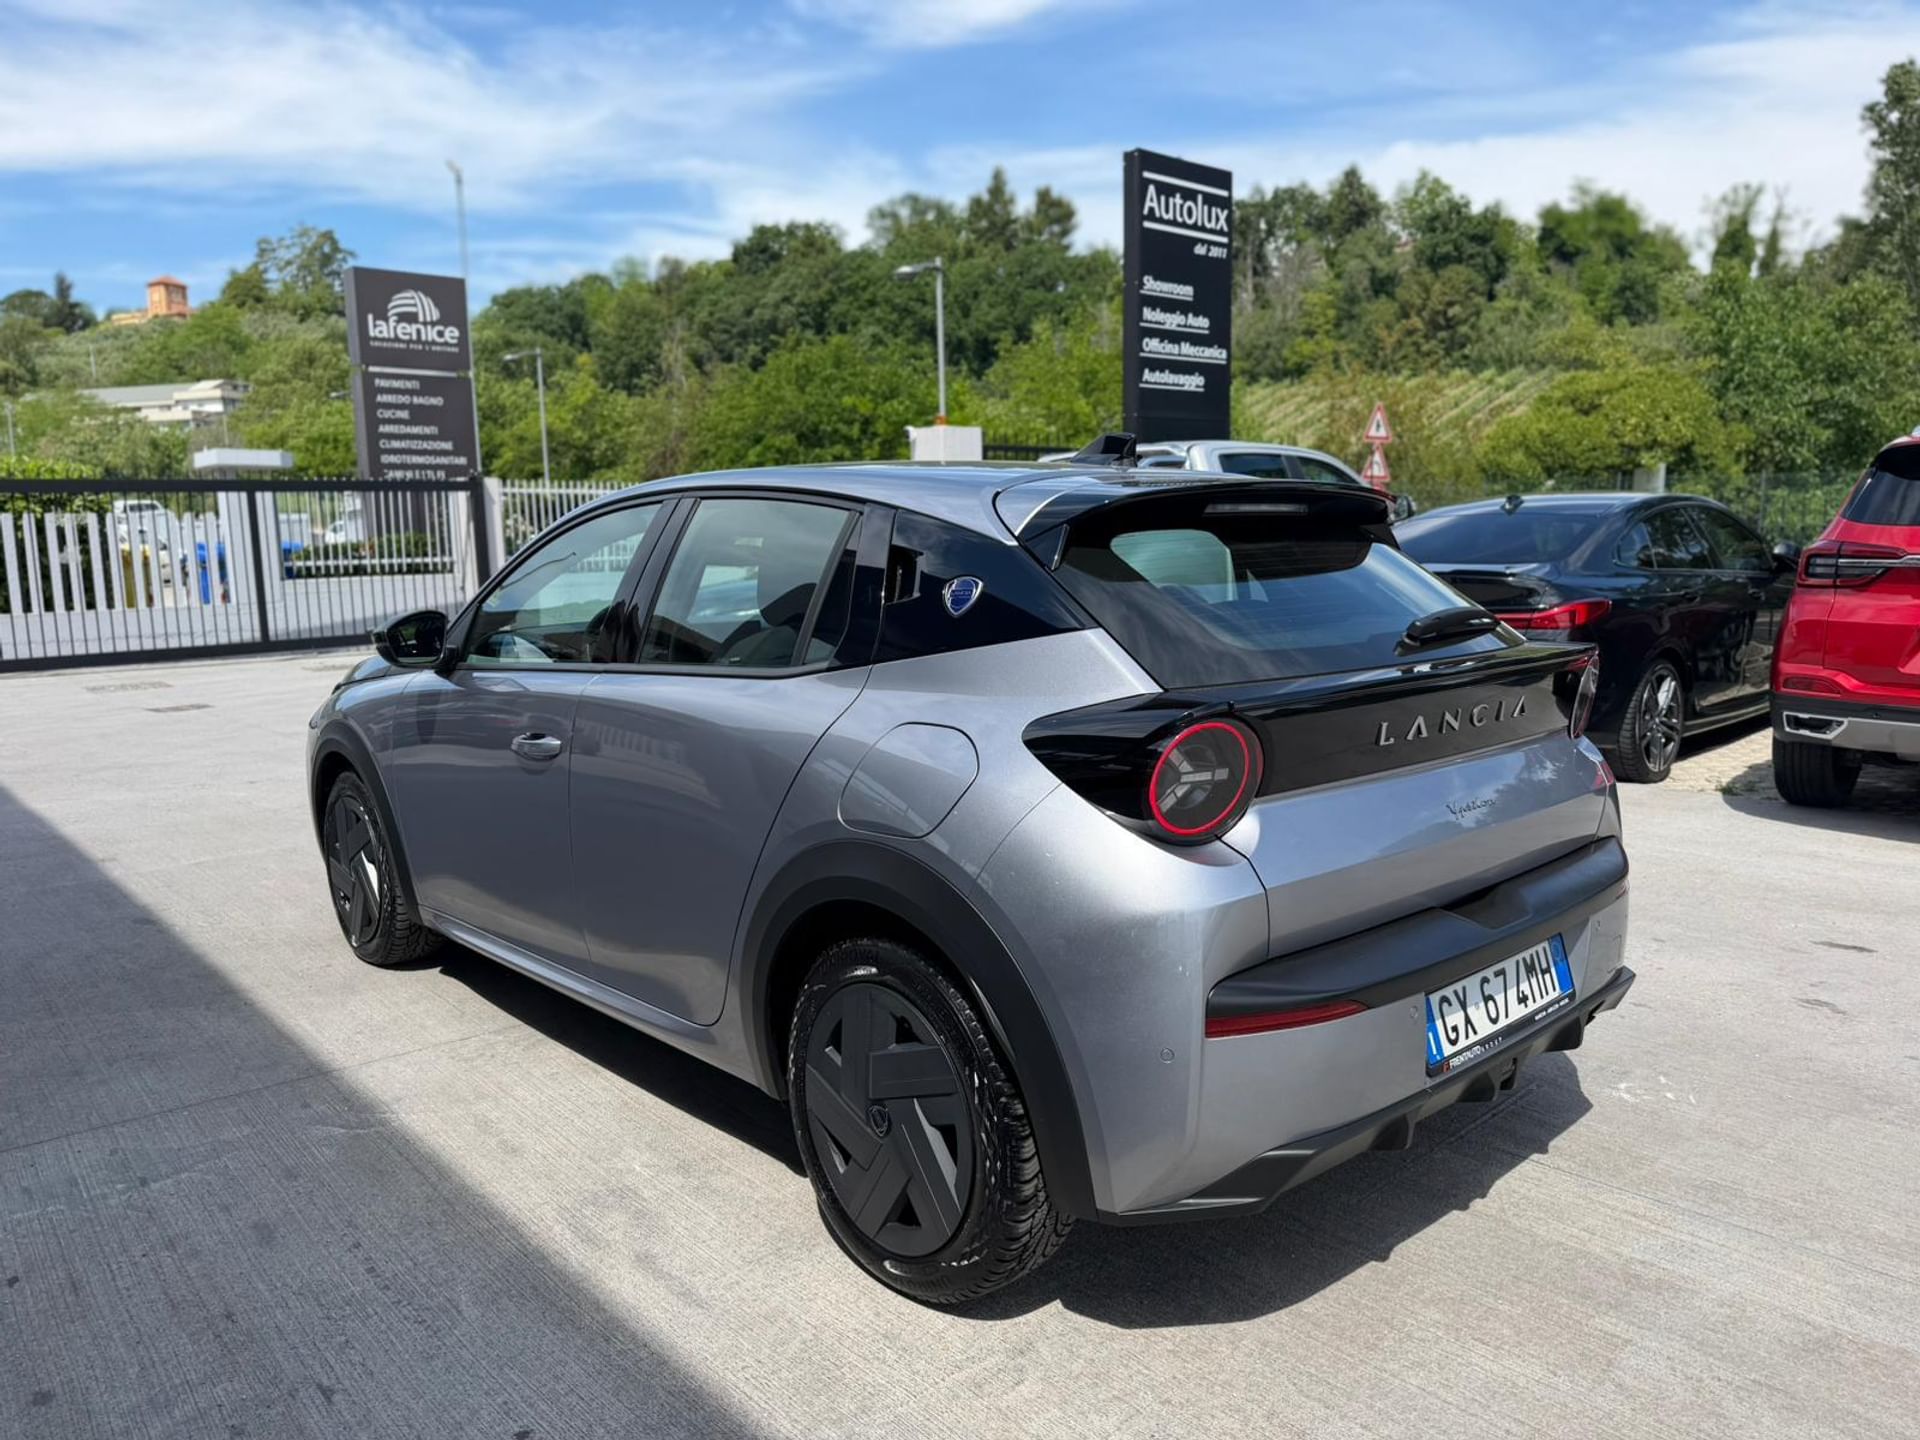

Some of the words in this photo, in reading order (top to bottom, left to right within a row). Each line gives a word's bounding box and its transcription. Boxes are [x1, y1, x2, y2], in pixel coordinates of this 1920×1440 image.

[1143, 184, 1228, 232] Autolux
[1143, 275, 1194, 297] Showroom
[1143, 307, 1186, 328] Noleggio
[1187, 313, 1209, 328] Auto
[367, 313, 460, 344] lafenice
[1142, 337, 1179, 355] Officina
[1180, 341, 1227, 360] Meccanica
[374, 377, 420, 390] PAVIMENTI
[1142, 368, 1205, 390] Autolavaggio
[376, 393, 411, 405] ARREDO
[412, 395, 444, 406] BAGNO
[376, 408, 410, 420] CUCINE
[377, 423, 439, 436] ARREDAMENTI
[379, 439, 454, 451] CLIMATIZZAZIONE
[380, 453, 468, 466] IDROTERMOSANITARI
[1379, 695, 1527, 746] LANCIA
[1438, 985, 1478, 1046] GX
[1479, 946, 1557, 1026] 674MH
